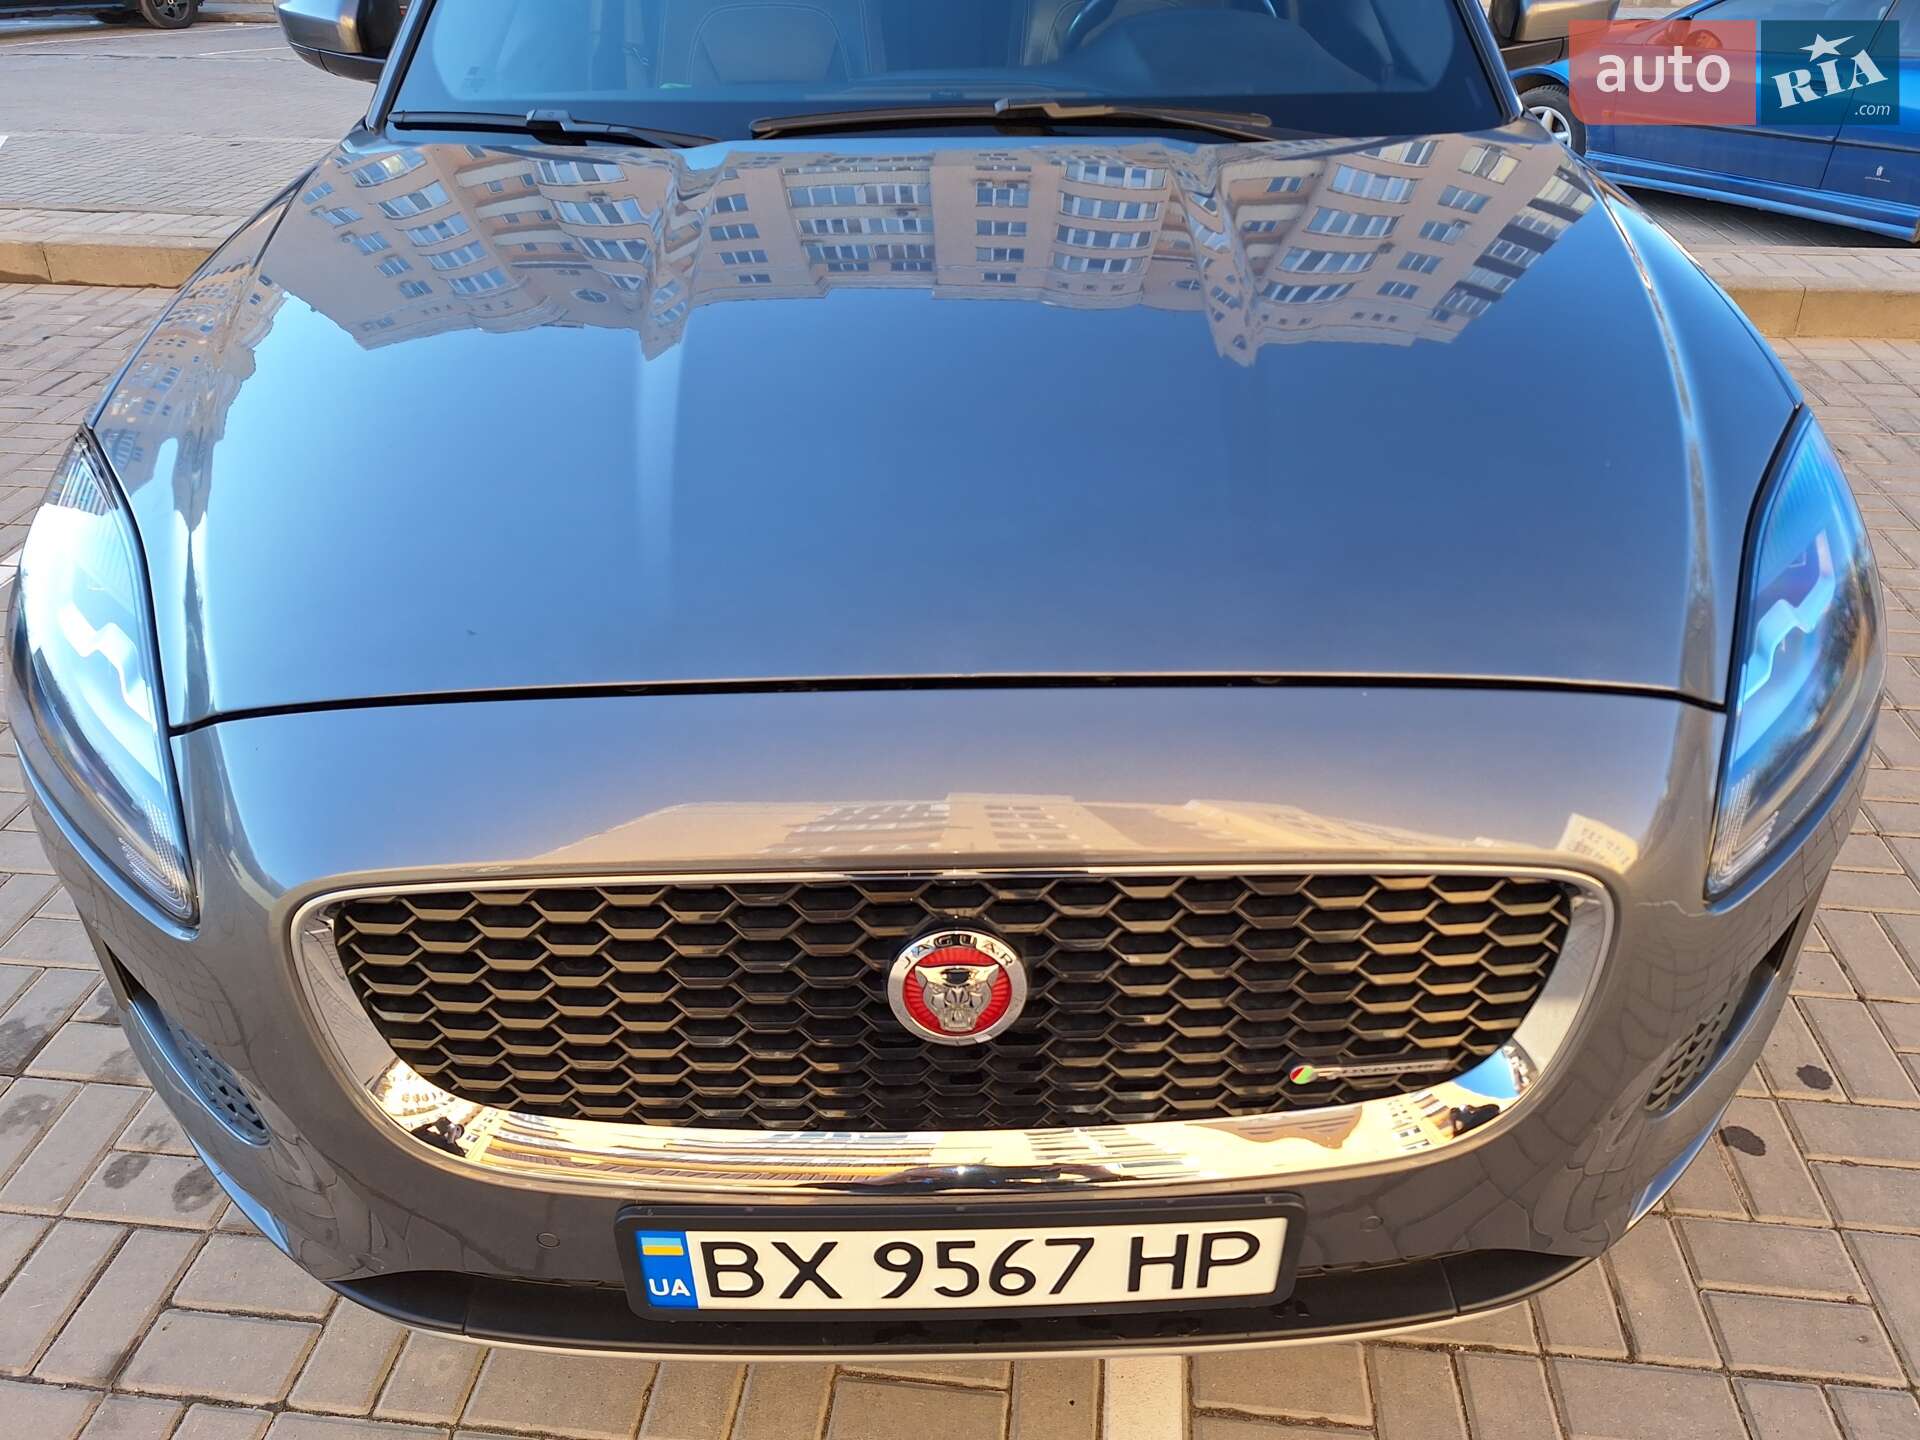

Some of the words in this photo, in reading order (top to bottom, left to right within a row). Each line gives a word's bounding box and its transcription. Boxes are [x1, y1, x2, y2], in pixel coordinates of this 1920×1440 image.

[903, 933, 1014, 969] JAGUAR
[700, 1240, 843, 1299] BX
[873, 1237, 1095, 1299] 9567
[1127, 1230, 1261, 1292] HP
[649, 1278, 691, 1297] UA
